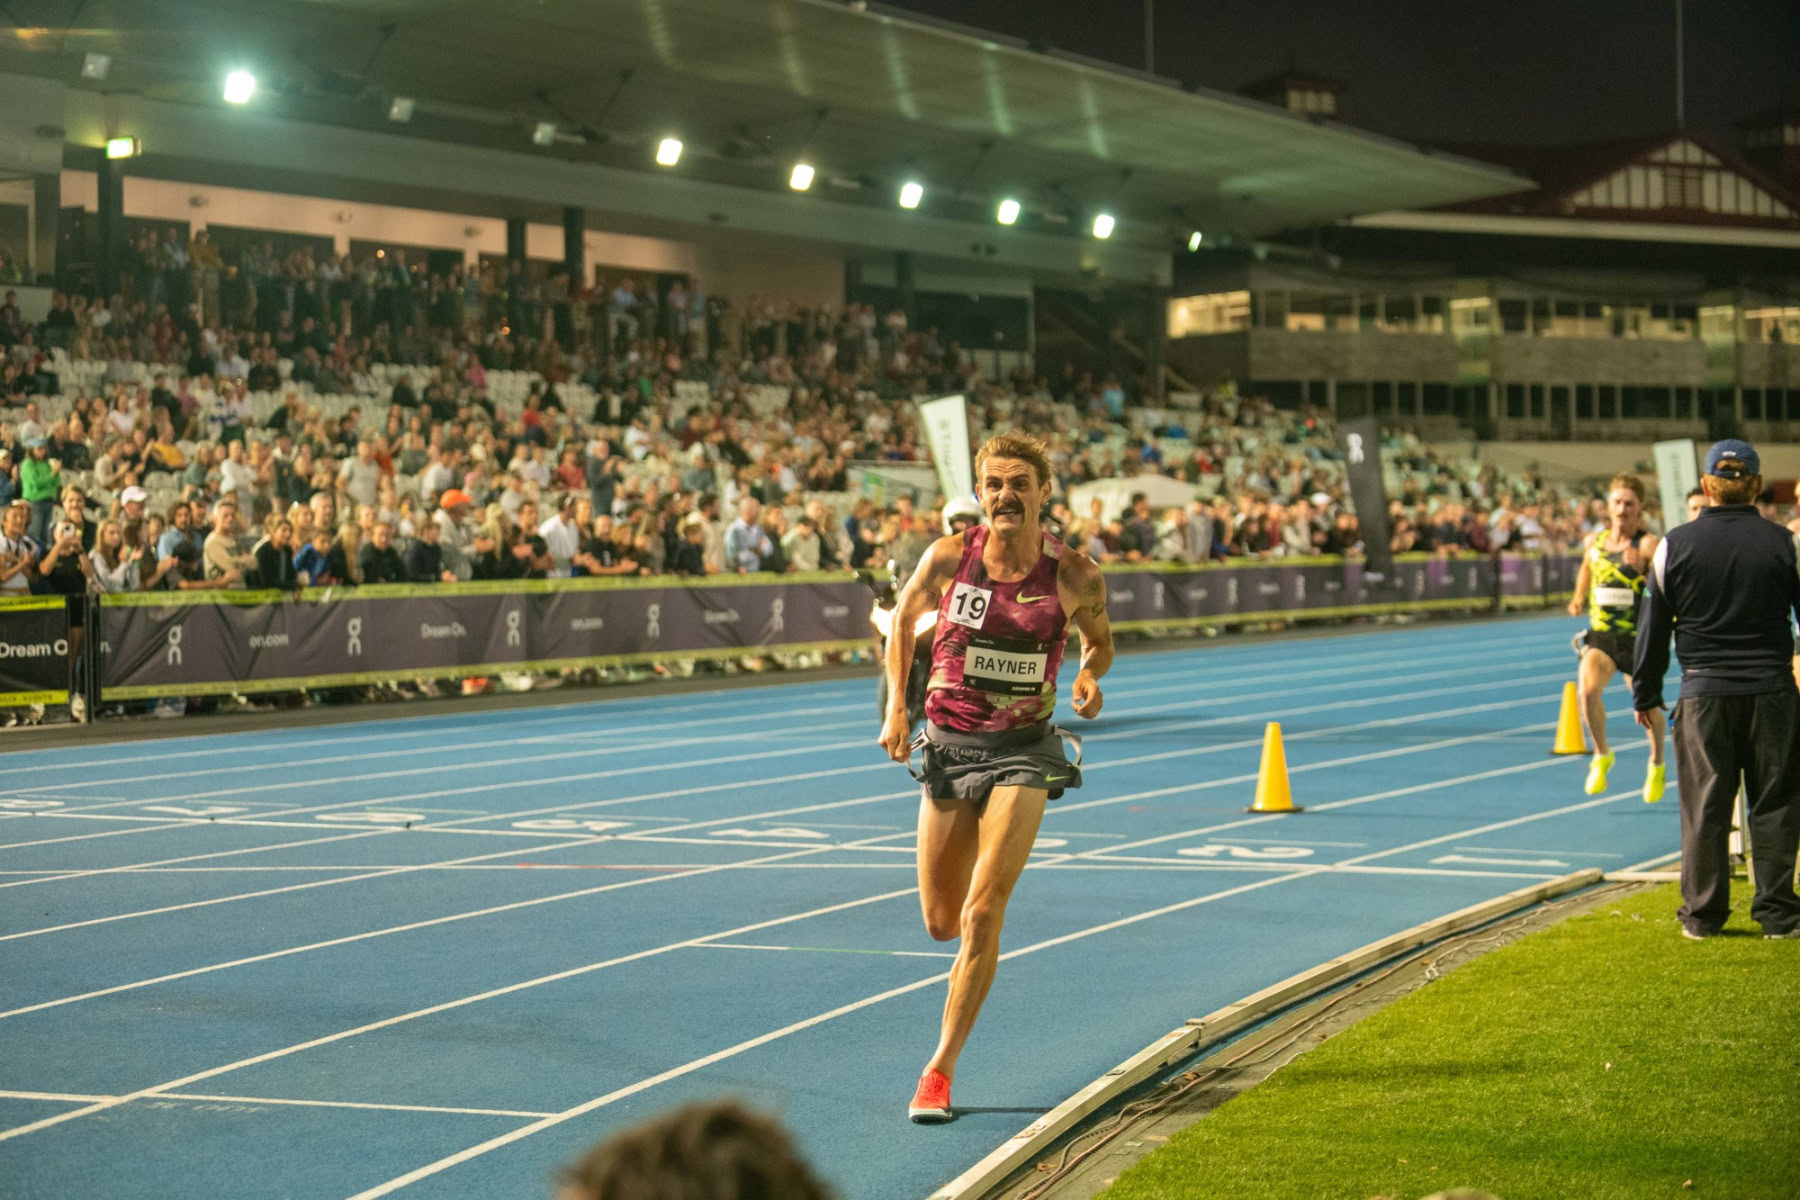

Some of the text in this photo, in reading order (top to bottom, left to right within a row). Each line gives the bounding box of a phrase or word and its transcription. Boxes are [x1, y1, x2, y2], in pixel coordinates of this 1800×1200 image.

[956, 592, 987, 620] 19
[250, 634, 289, 648] on.com
[0, 642, 51, 658] Dream
[974, 655, 1037, 675] RAYNER
[1176, 844, 1316, 859] 2
[1428, 854, 1570, 867] 1
